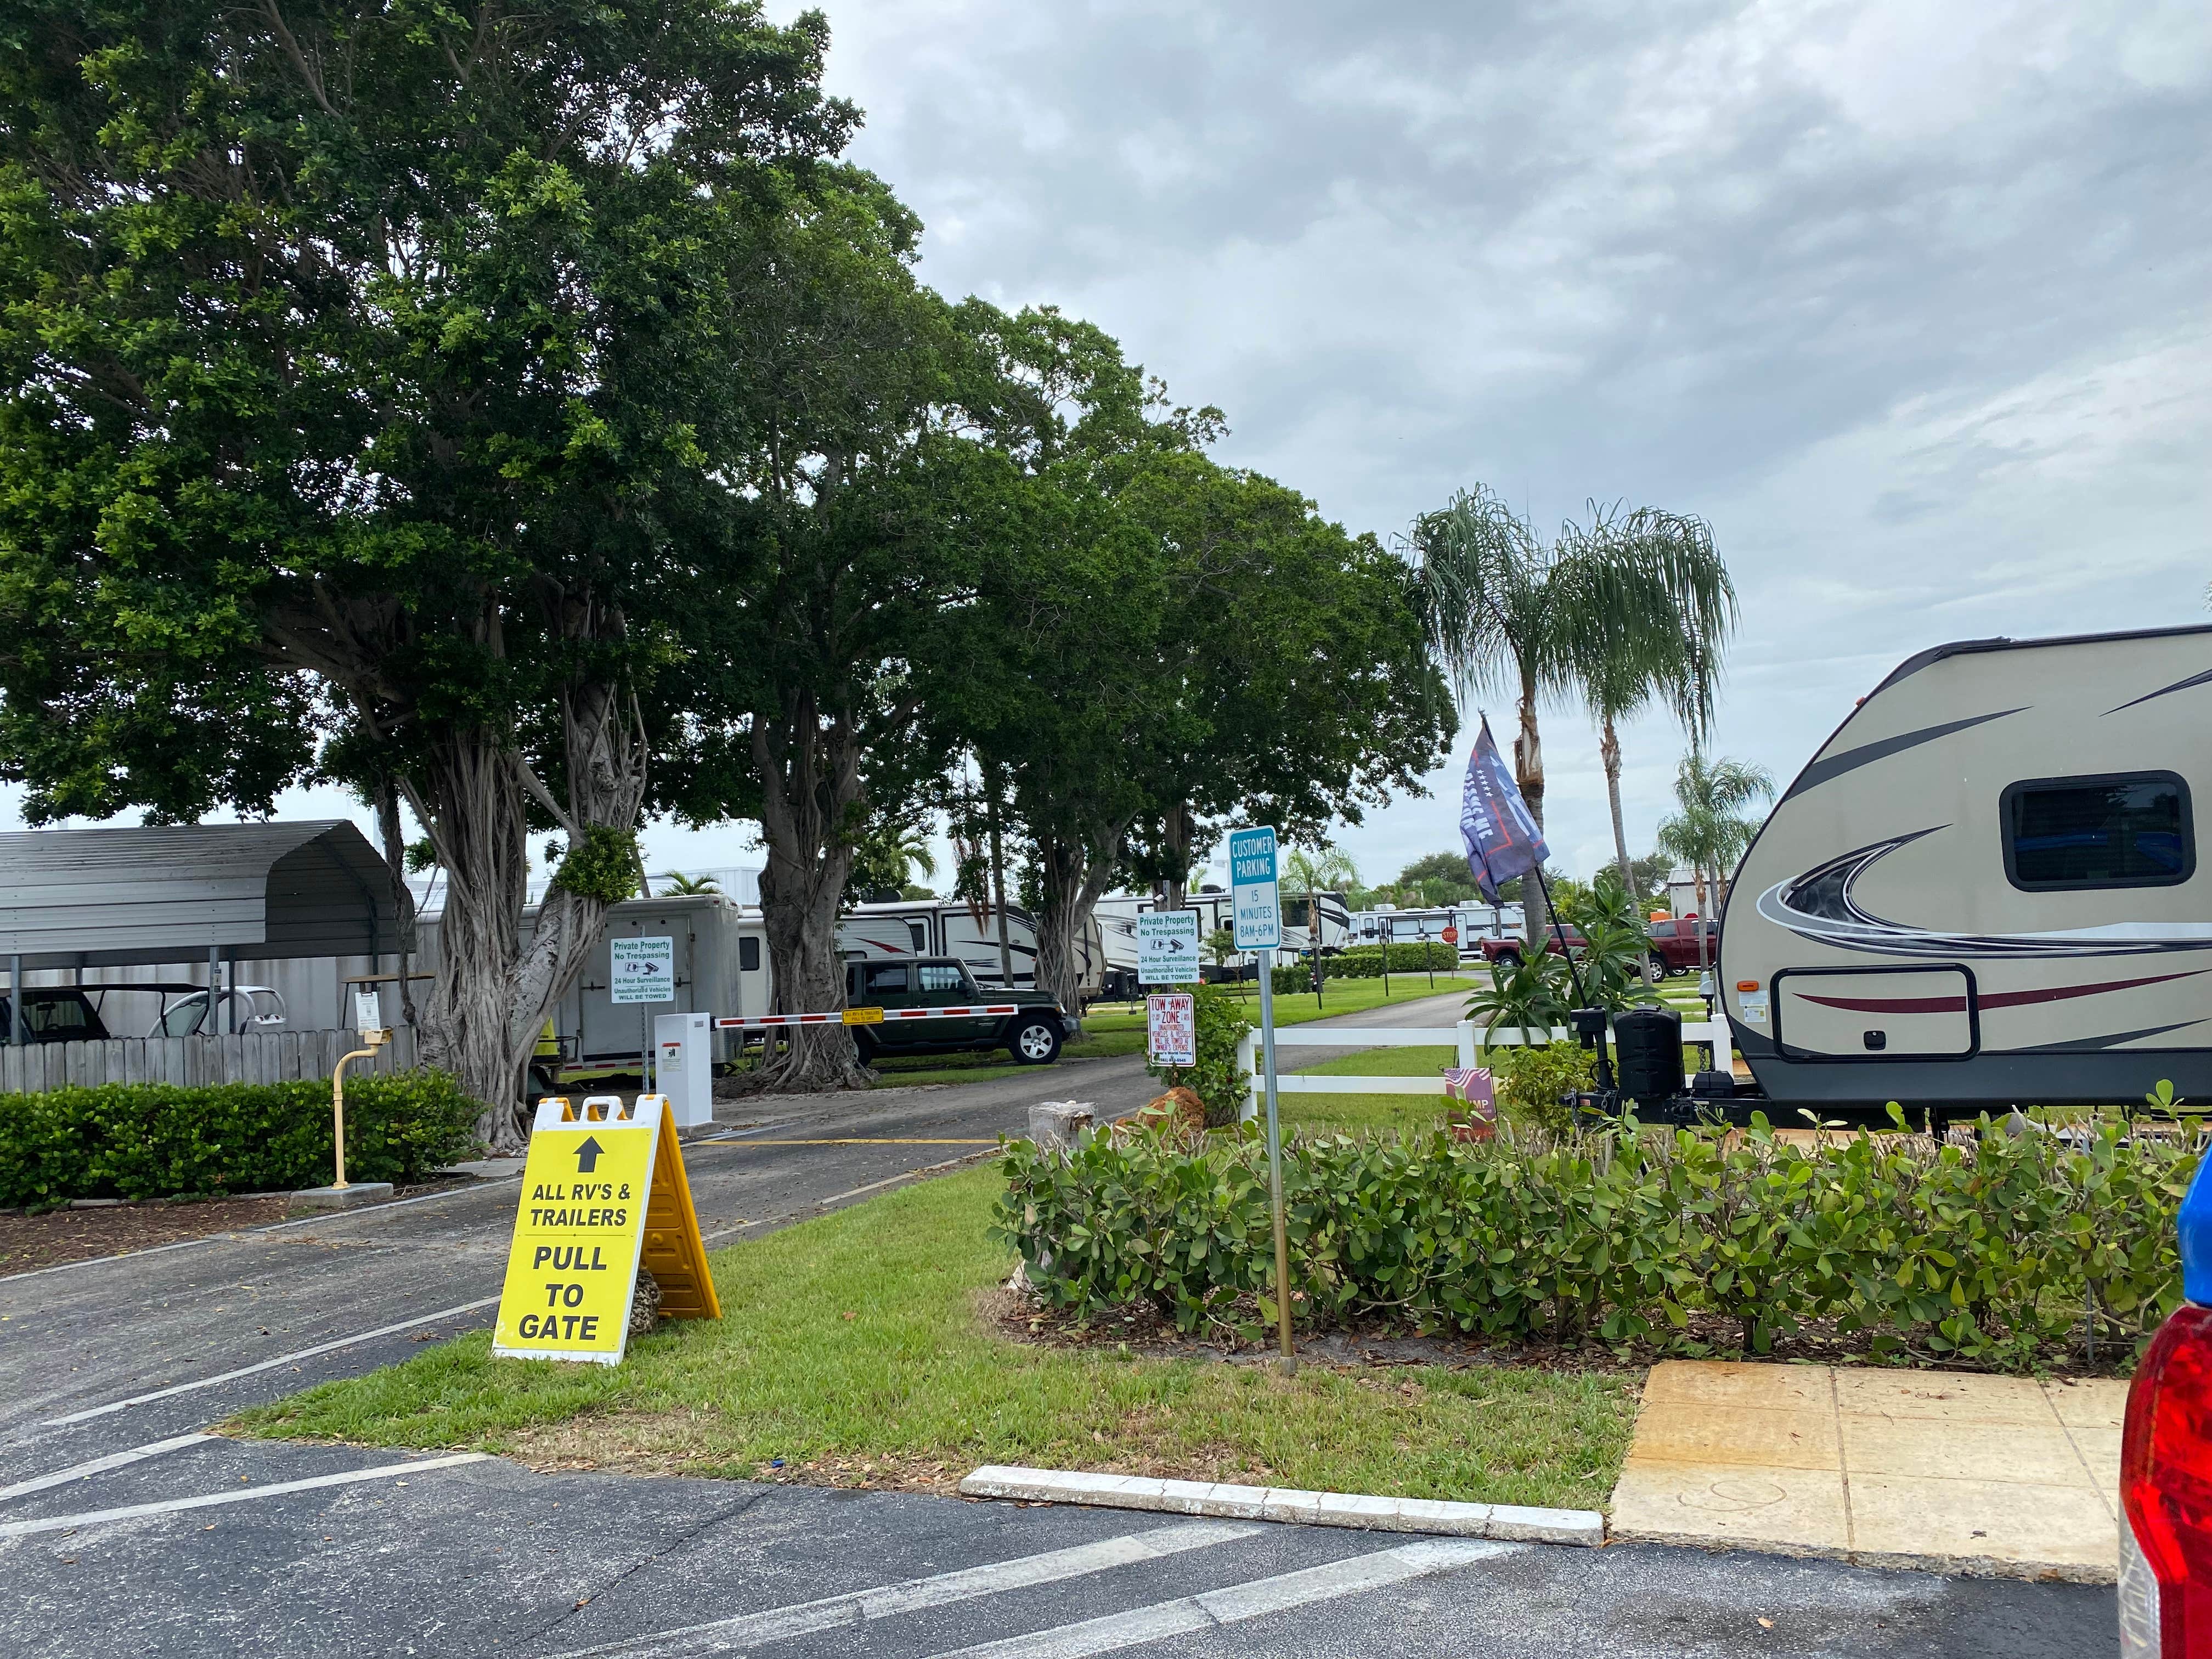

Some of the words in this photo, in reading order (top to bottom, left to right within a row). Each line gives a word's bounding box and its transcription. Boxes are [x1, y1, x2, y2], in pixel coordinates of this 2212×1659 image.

[1233, 836, 1273, 858] CUSTOMER
[1237, 857, 1270, 878] PARKING
[1251, 890, 1259, 902] 15
[1140, 916, 1163, 926] Private
[1165, 915, 1194, 926] Property
[1240, 906, 1272, 921] MINUTES
[1152, 927, 1194, 936] Trespassing
[1240, 923, 1274, 938] 8AM-6PM
[614, 942, 638, 950] Private
[641, 941, 670, 950] Property
[627, 952, 669, 960] Trespassing
[1151, 998, 1165, 1011] TOW
[1161, 1011, 1180, 1023] ZONE
[532, 1184, 566, 1200] ALL
[572, 1183, 612, 1200] RV'S
[618, 1183, 630, 1200] &
[531, 1208, 627, 1226] TRAILERS
[533, 1246, 607, 1271] PULL
[545, 1284, 584, 1308] TO
[519, 1314, 599, 1340] GATE
